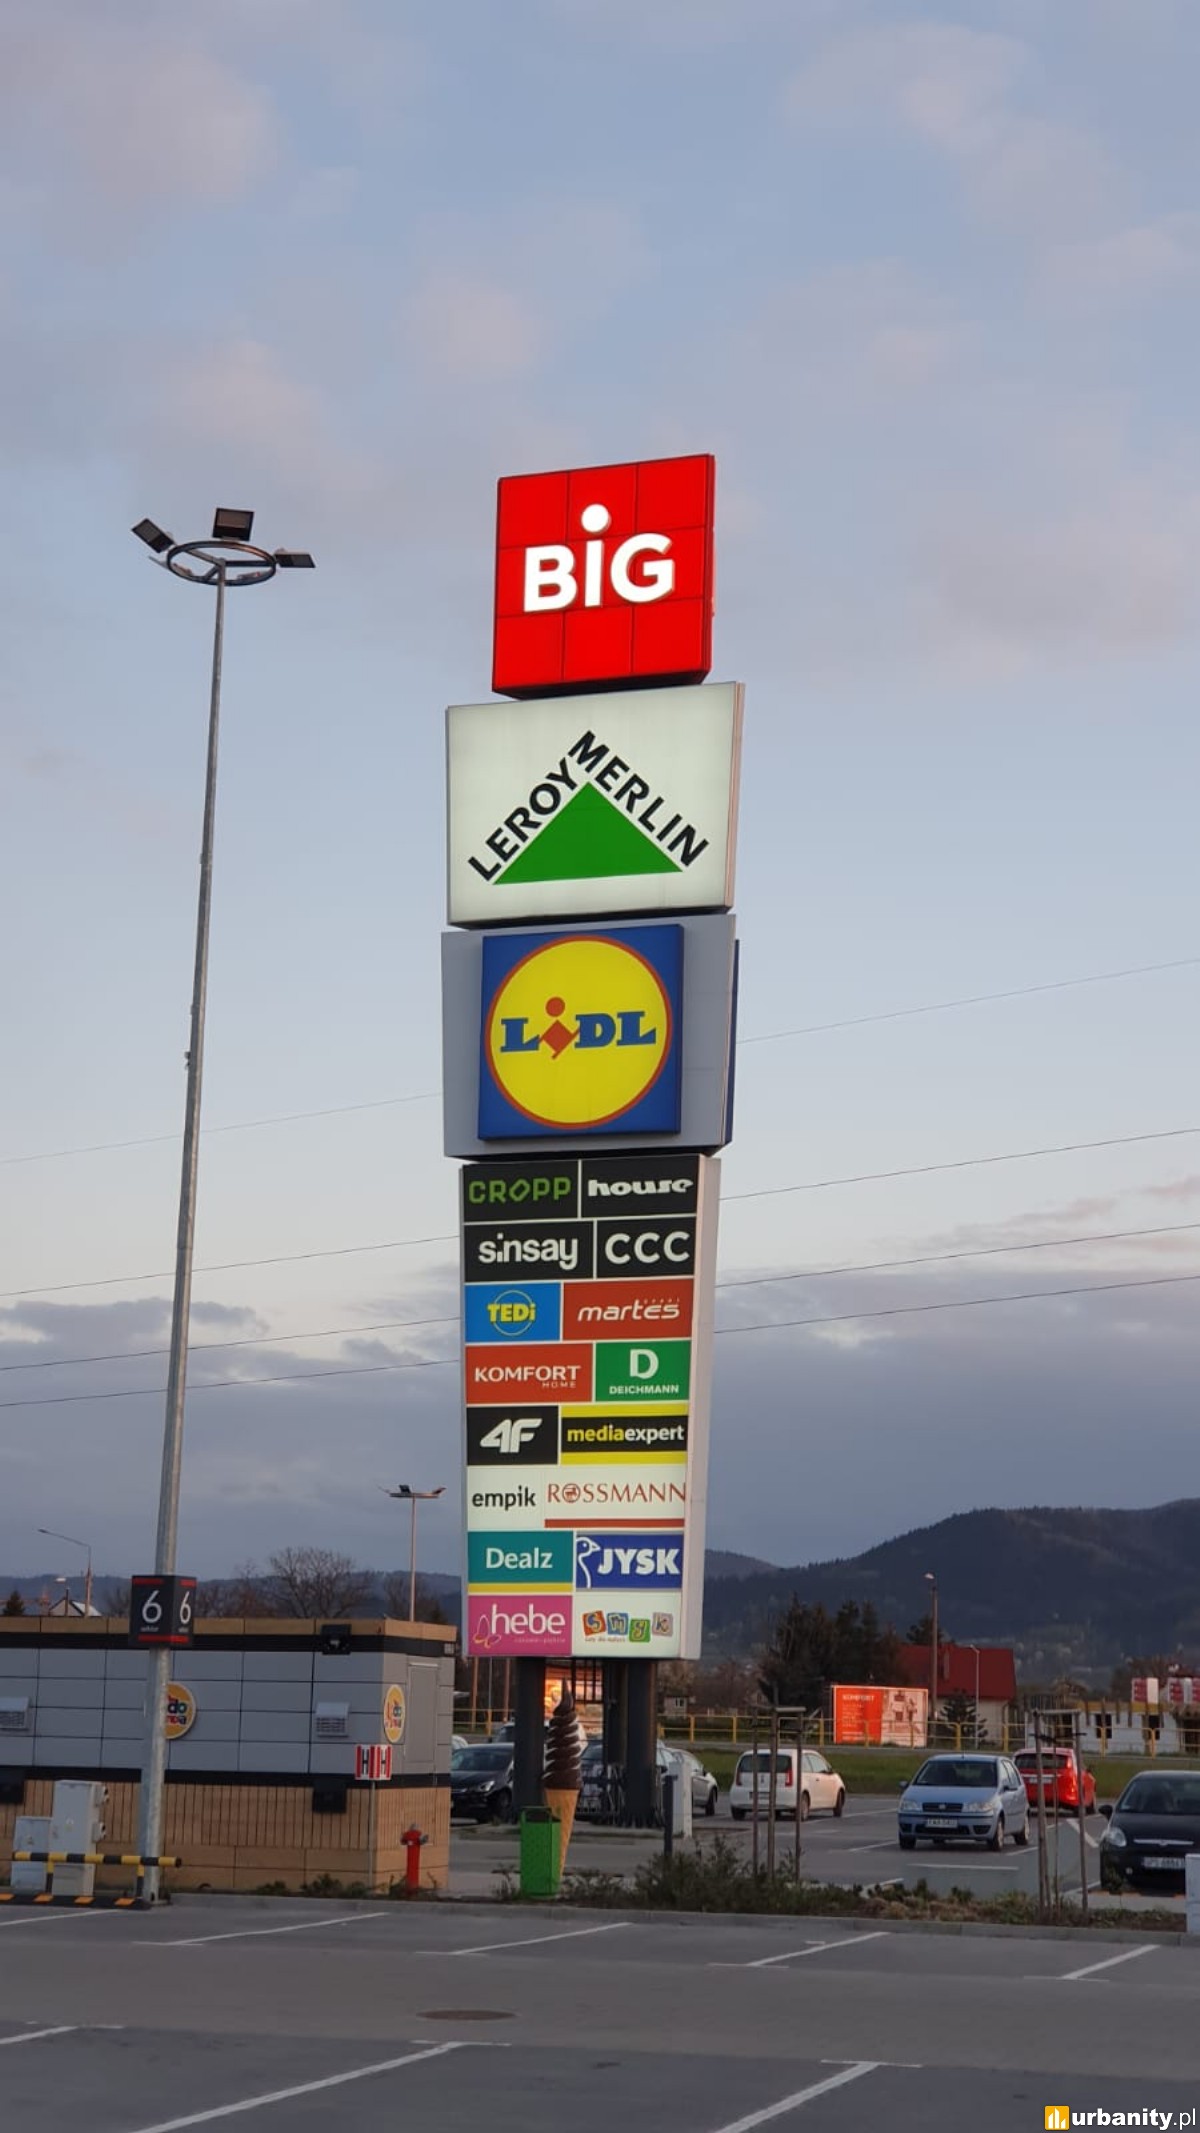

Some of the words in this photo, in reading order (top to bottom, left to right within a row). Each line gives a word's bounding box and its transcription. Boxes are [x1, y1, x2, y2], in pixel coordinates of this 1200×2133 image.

[467, 757, 579, 882] LEROY
[567, 730, 710, 867] MERLIN
[468, 1176, 571, 1204] CROPP
[587, 1178, 694, 1198] house
[478, 1232, 579, 1270] sinsay
[604, 1230, 691, 1265] CCC
[486, 1303, 536, 1323] TEDi
[577, 1298, 680, 1322] martes
[474, 1364, 581, 1383] KOMFORT
[629, 1348, 660, 1379] D
[541, 1380, 577, 1389] HOME
[609, 1384, 680, 1396] DEICHMANN
[479, 1418, 543, 1453] 4F
[566, 1423, 685, 1445] mediaexpert
[472, 1485, 537, 1511] empik
[547, 1482, 687, 1504] ROSSMANN
[485, 1546, 553, 1569] Dealz
[597, 1548, 681, 1576] JYSK
[142, 1589, 162, 1624] 6
[180, 1590, 192, 1625] 6
[491, 1603, 566, 1635] hebe
